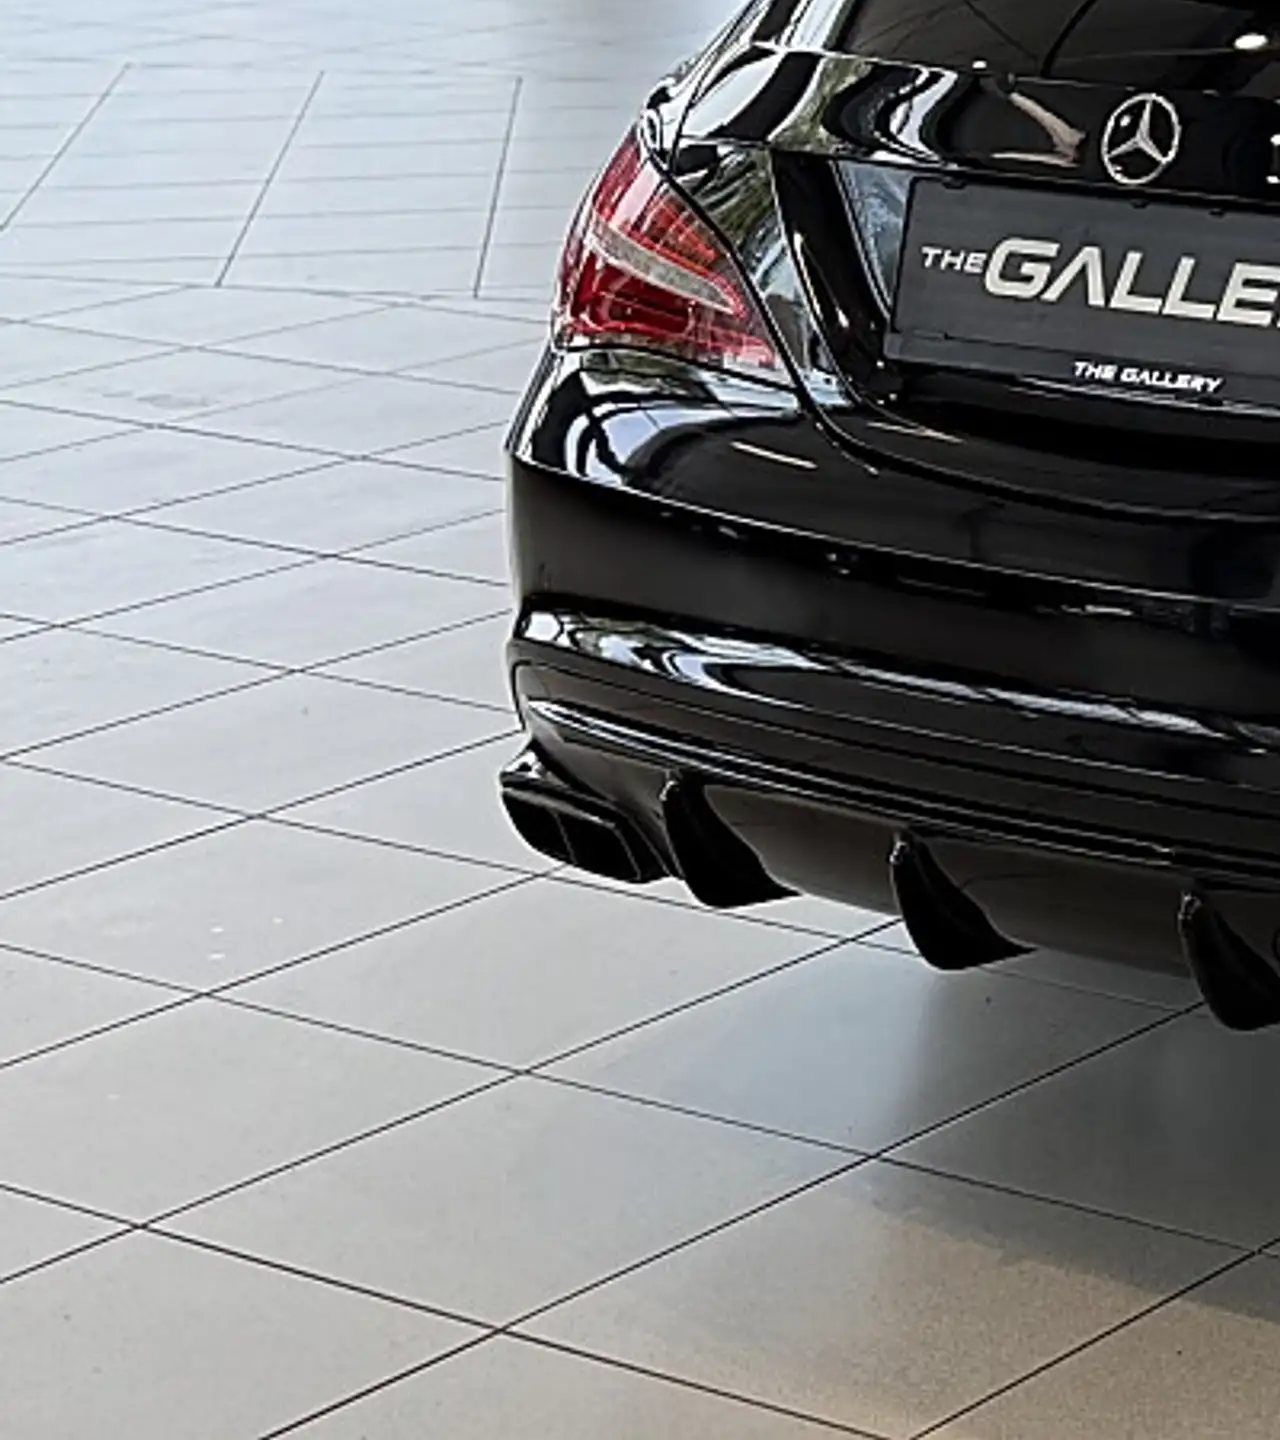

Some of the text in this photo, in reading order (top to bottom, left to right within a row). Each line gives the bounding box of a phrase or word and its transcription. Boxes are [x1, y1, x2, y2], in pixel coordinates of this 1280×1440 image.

[921, 246, 988, 274] THE
[1074, 361, 1224, 393] THE GALLERY
